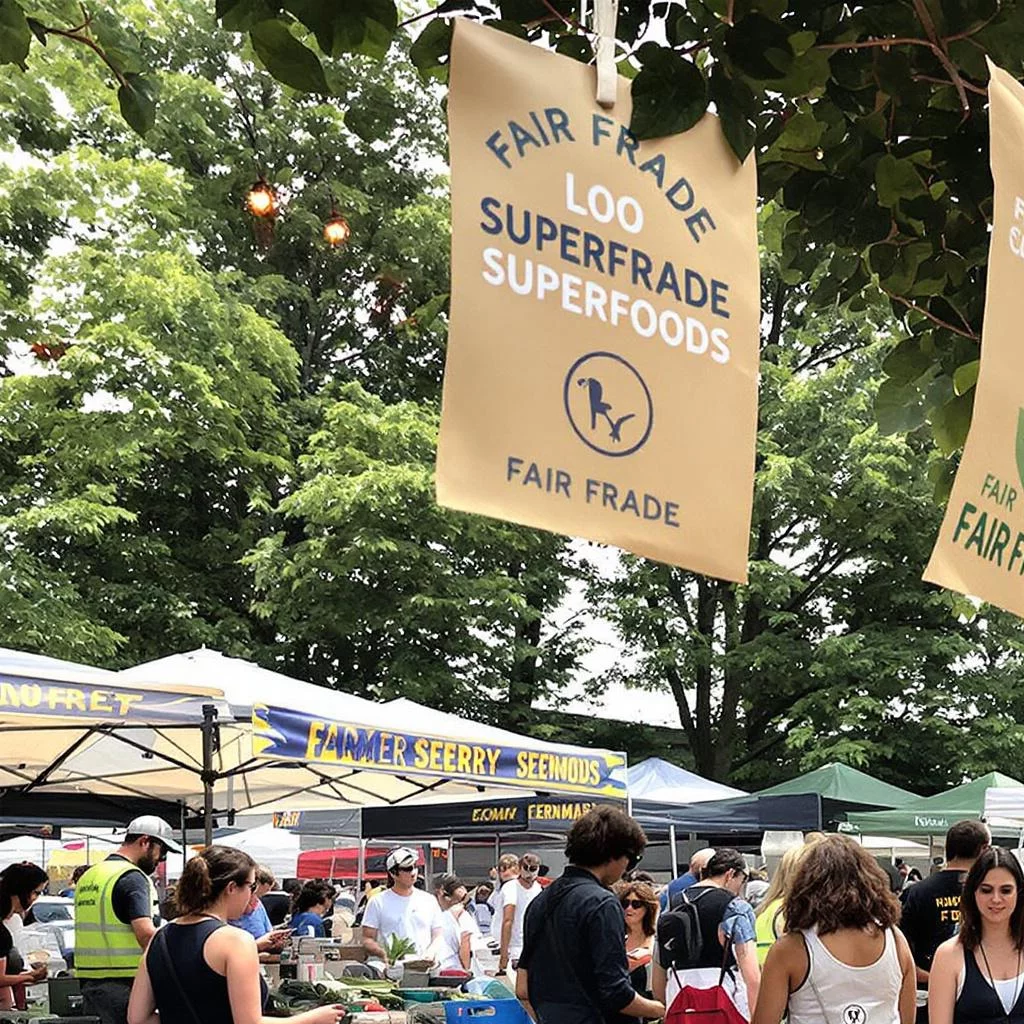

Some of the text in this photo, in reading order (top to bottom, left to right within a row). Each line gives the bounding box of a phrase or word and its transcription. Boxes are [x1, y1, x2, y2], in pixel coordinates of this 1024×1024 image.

[485, 107, 716, 244] FAIR FRADE
[566, 172, 644, 235] LOO
[481, 197, 731, 319] SUPERFRADE
[482, 248, 731, 365] SUPERFOODS
[507, 457, 681, 528] FAIR FRADE
[981, 473, 1018, 512] FAIR
[953, 502, 1011, 567] FAIR
[415, 737, 501, 775] SEERRY
